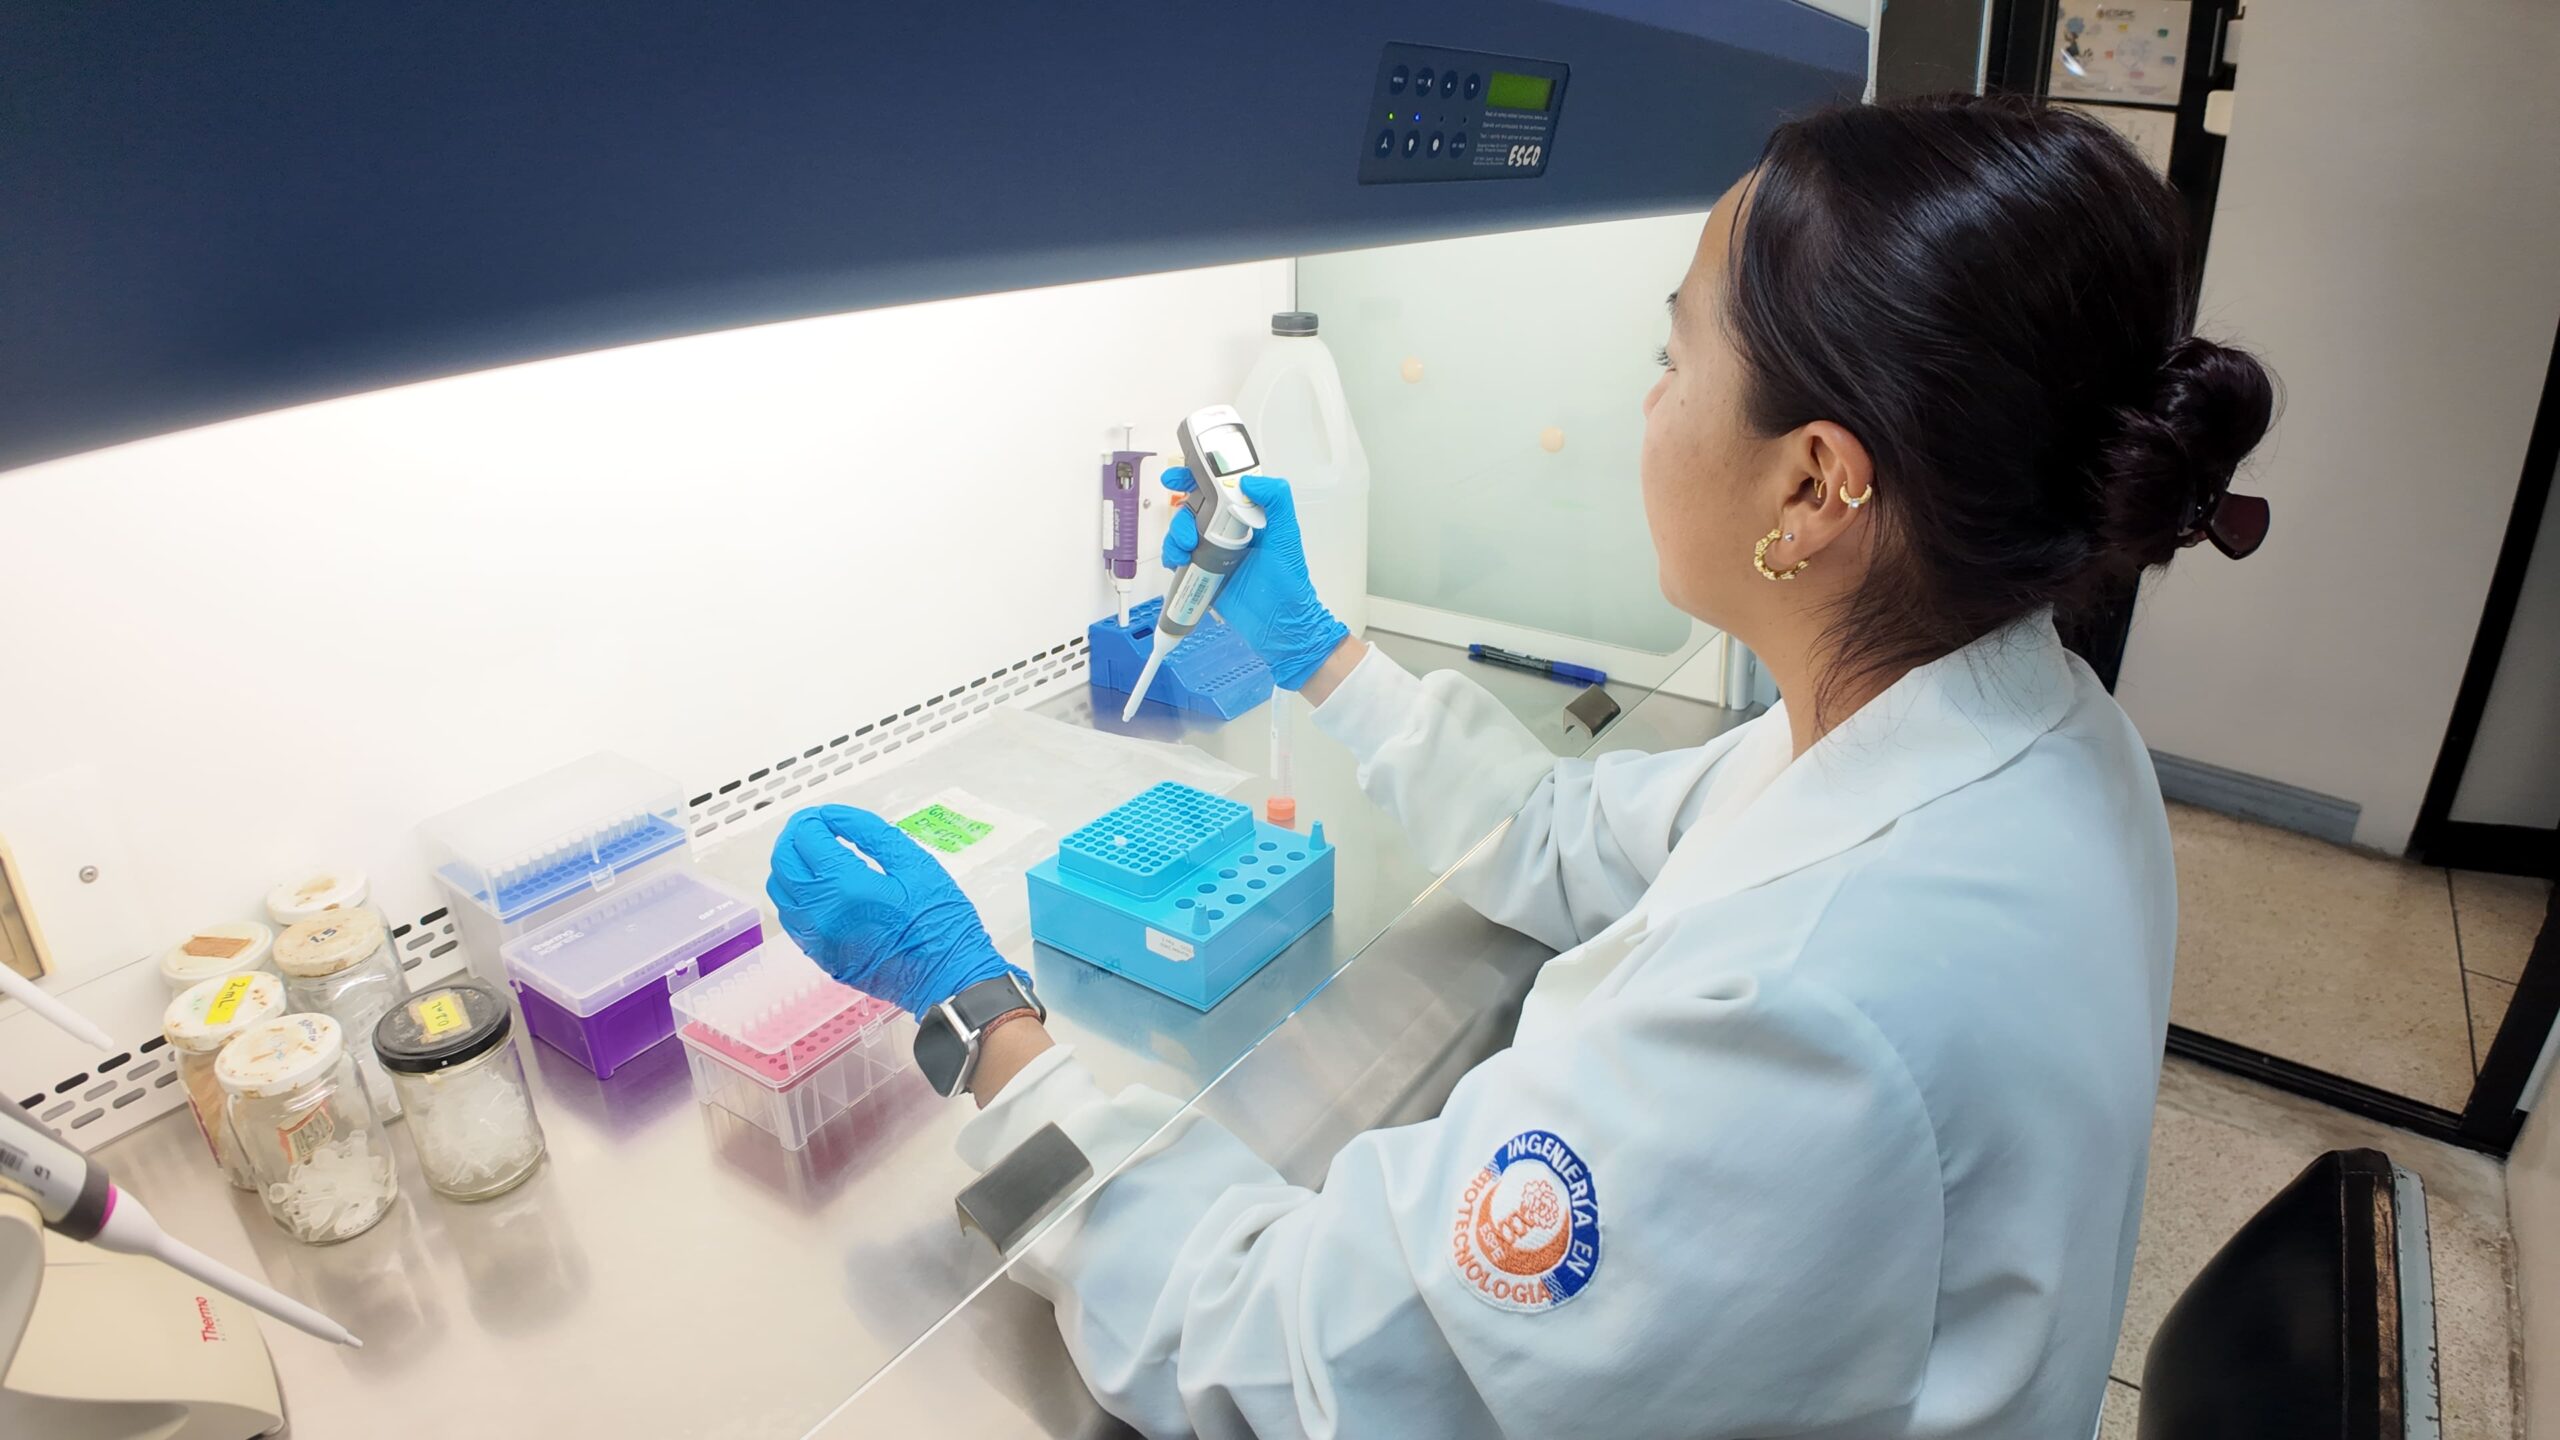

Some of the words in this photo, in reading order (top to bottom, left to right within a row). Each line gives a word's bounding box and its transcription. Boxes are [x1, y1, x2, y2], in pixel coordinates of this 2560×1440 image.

[1508, 144, 1541, 167] ESCO
[310, 927, 337, 943] 1.5
[1478, 1222, 1507, 1262] ESPE
[1567, 1239, 1593, 1278] EN
[195, 1296, 219, 1342] Thermo
